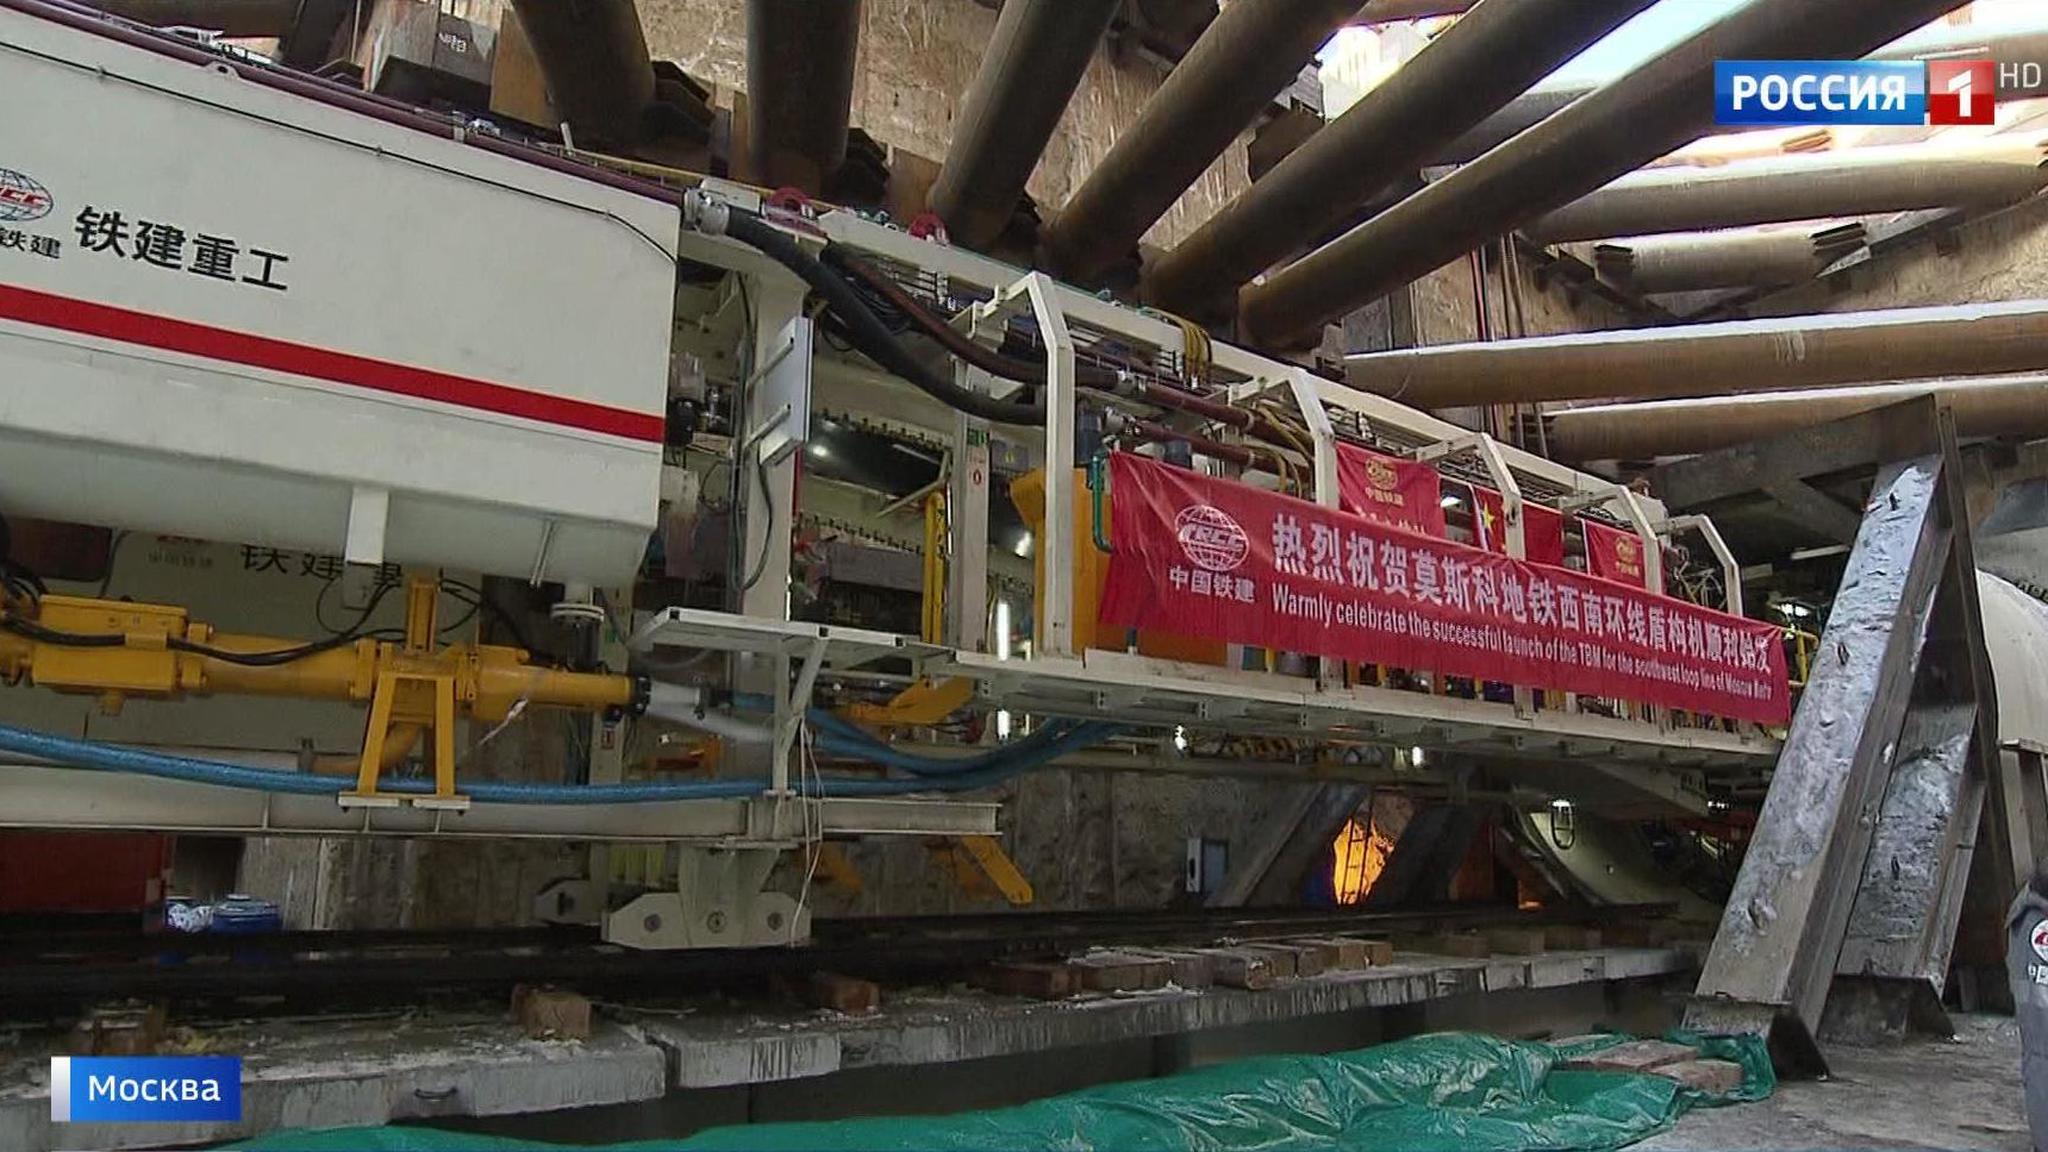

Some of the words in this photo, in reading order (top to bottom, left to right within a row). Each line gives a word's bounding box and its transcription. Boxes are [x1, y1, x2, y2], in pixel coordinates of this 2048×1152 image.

[75, 205, 289, 291] 铁建重工
[1168, 565, 1255, 604] 中国铁建
[1272, 511, 1770, 675] 热烈祝贺莫斯科地铁西南环线盾构机顺利始发
[1271, 581, 1333, 629] Warmly
[1335, 599, 1407, 634] celebrate
[1408, 610, 1431, 638] the
[1432, 621, 1502, 652] successful
[1502, 629, 1544, 658] launch
[1545, 637, 1558, 662] of
[1559, 638, 1578, 664] the
[1578, 642, 1601, 669] TBM
[1602, 646, 1617, 672] for
[1618, 651, 1634, 675] the
[1681, 662, 1700, 692] loop
